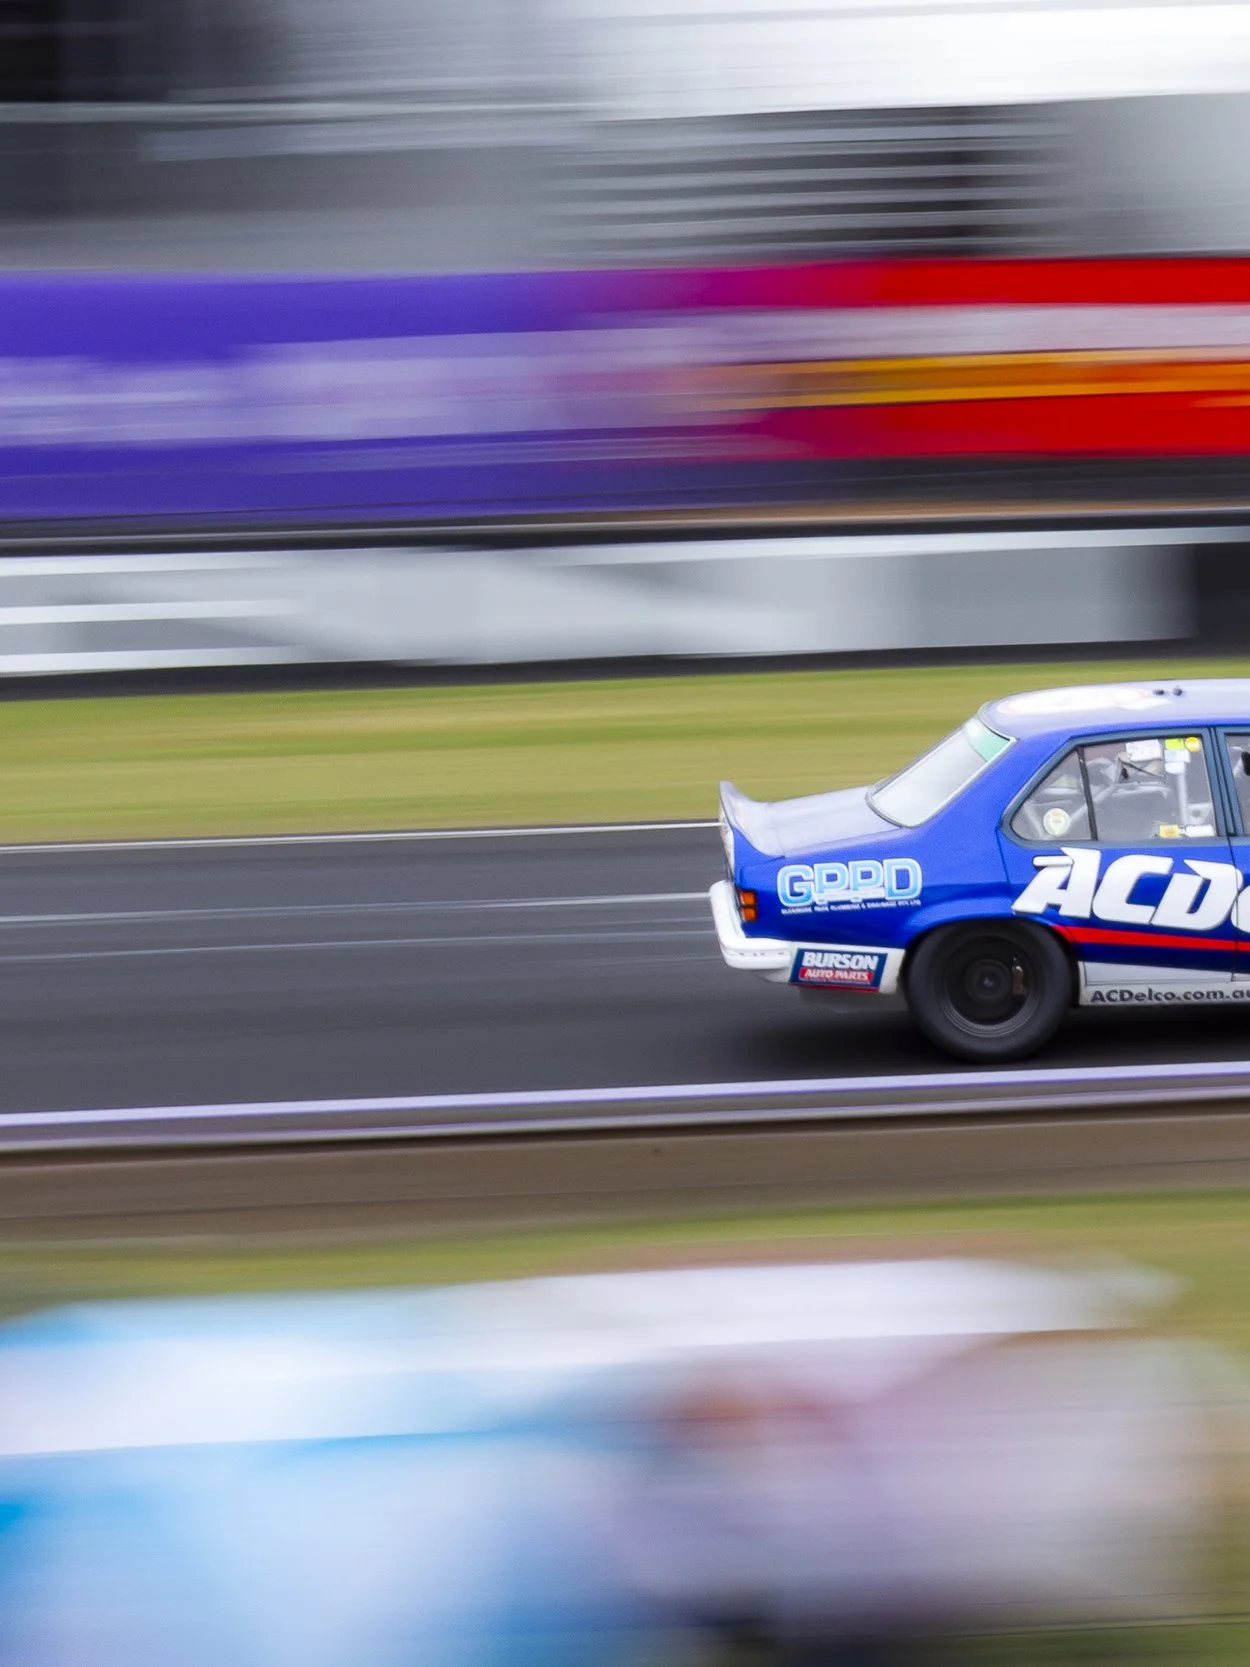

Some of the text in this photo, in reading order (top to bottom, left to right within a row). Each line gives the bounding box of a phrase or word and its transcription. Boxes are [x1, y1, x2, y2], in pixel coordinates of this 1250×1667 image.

[776, 858, 923, 907] GPPD
[802, 951, 879, 971] BURSON
[804, 968, 869, 981] AUTO PARTS
